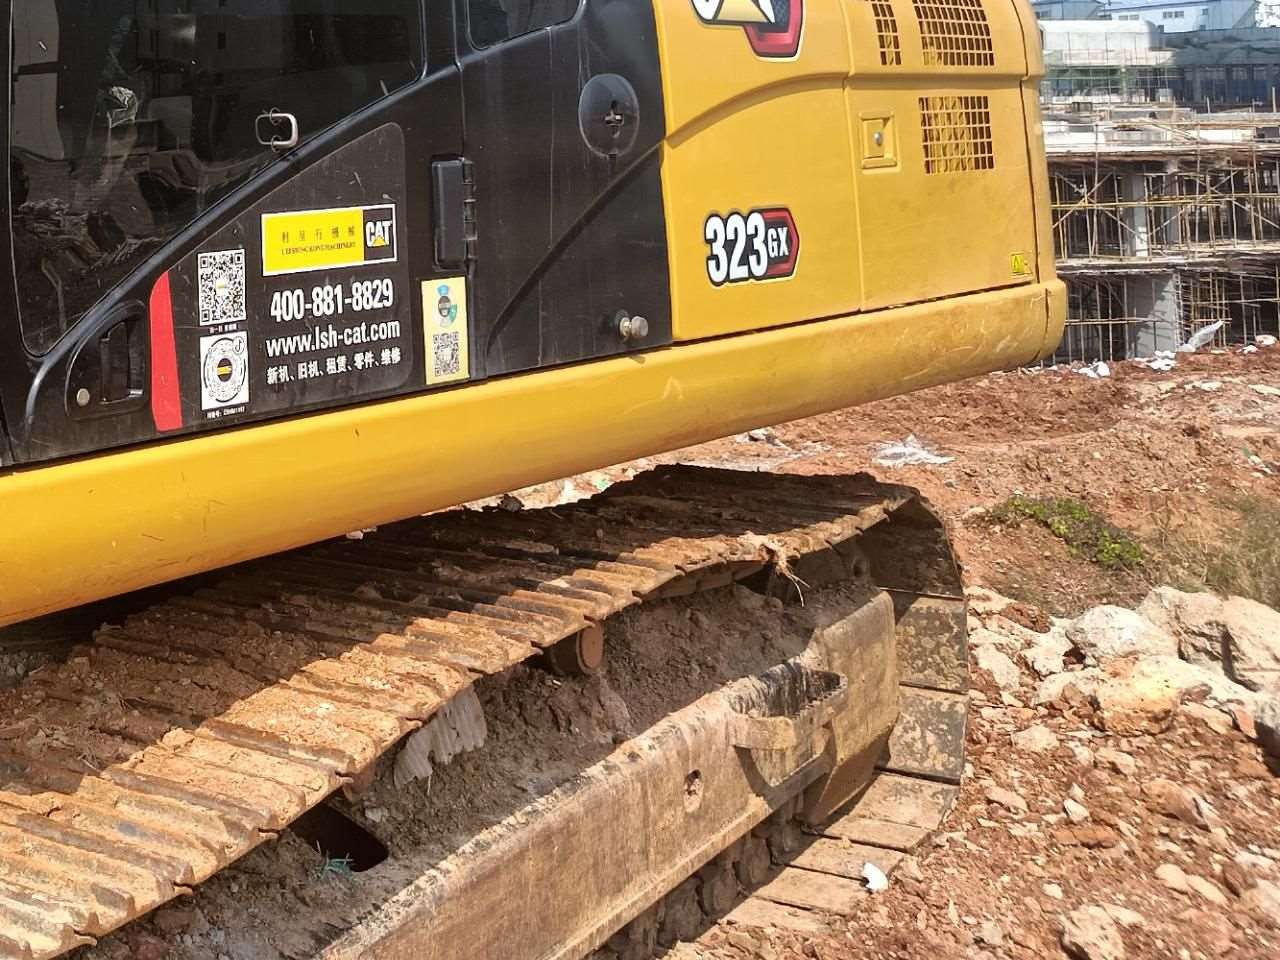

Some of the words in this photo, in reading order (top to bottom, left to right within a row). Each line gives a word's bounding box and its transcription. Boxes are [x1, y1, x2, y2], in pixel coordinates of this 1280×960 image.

[365, 220, 393, 248] CAT
[270, 278, 394, 323] 400-881-8829
[265, 320, 401, 358] www.lsh-cat.com
